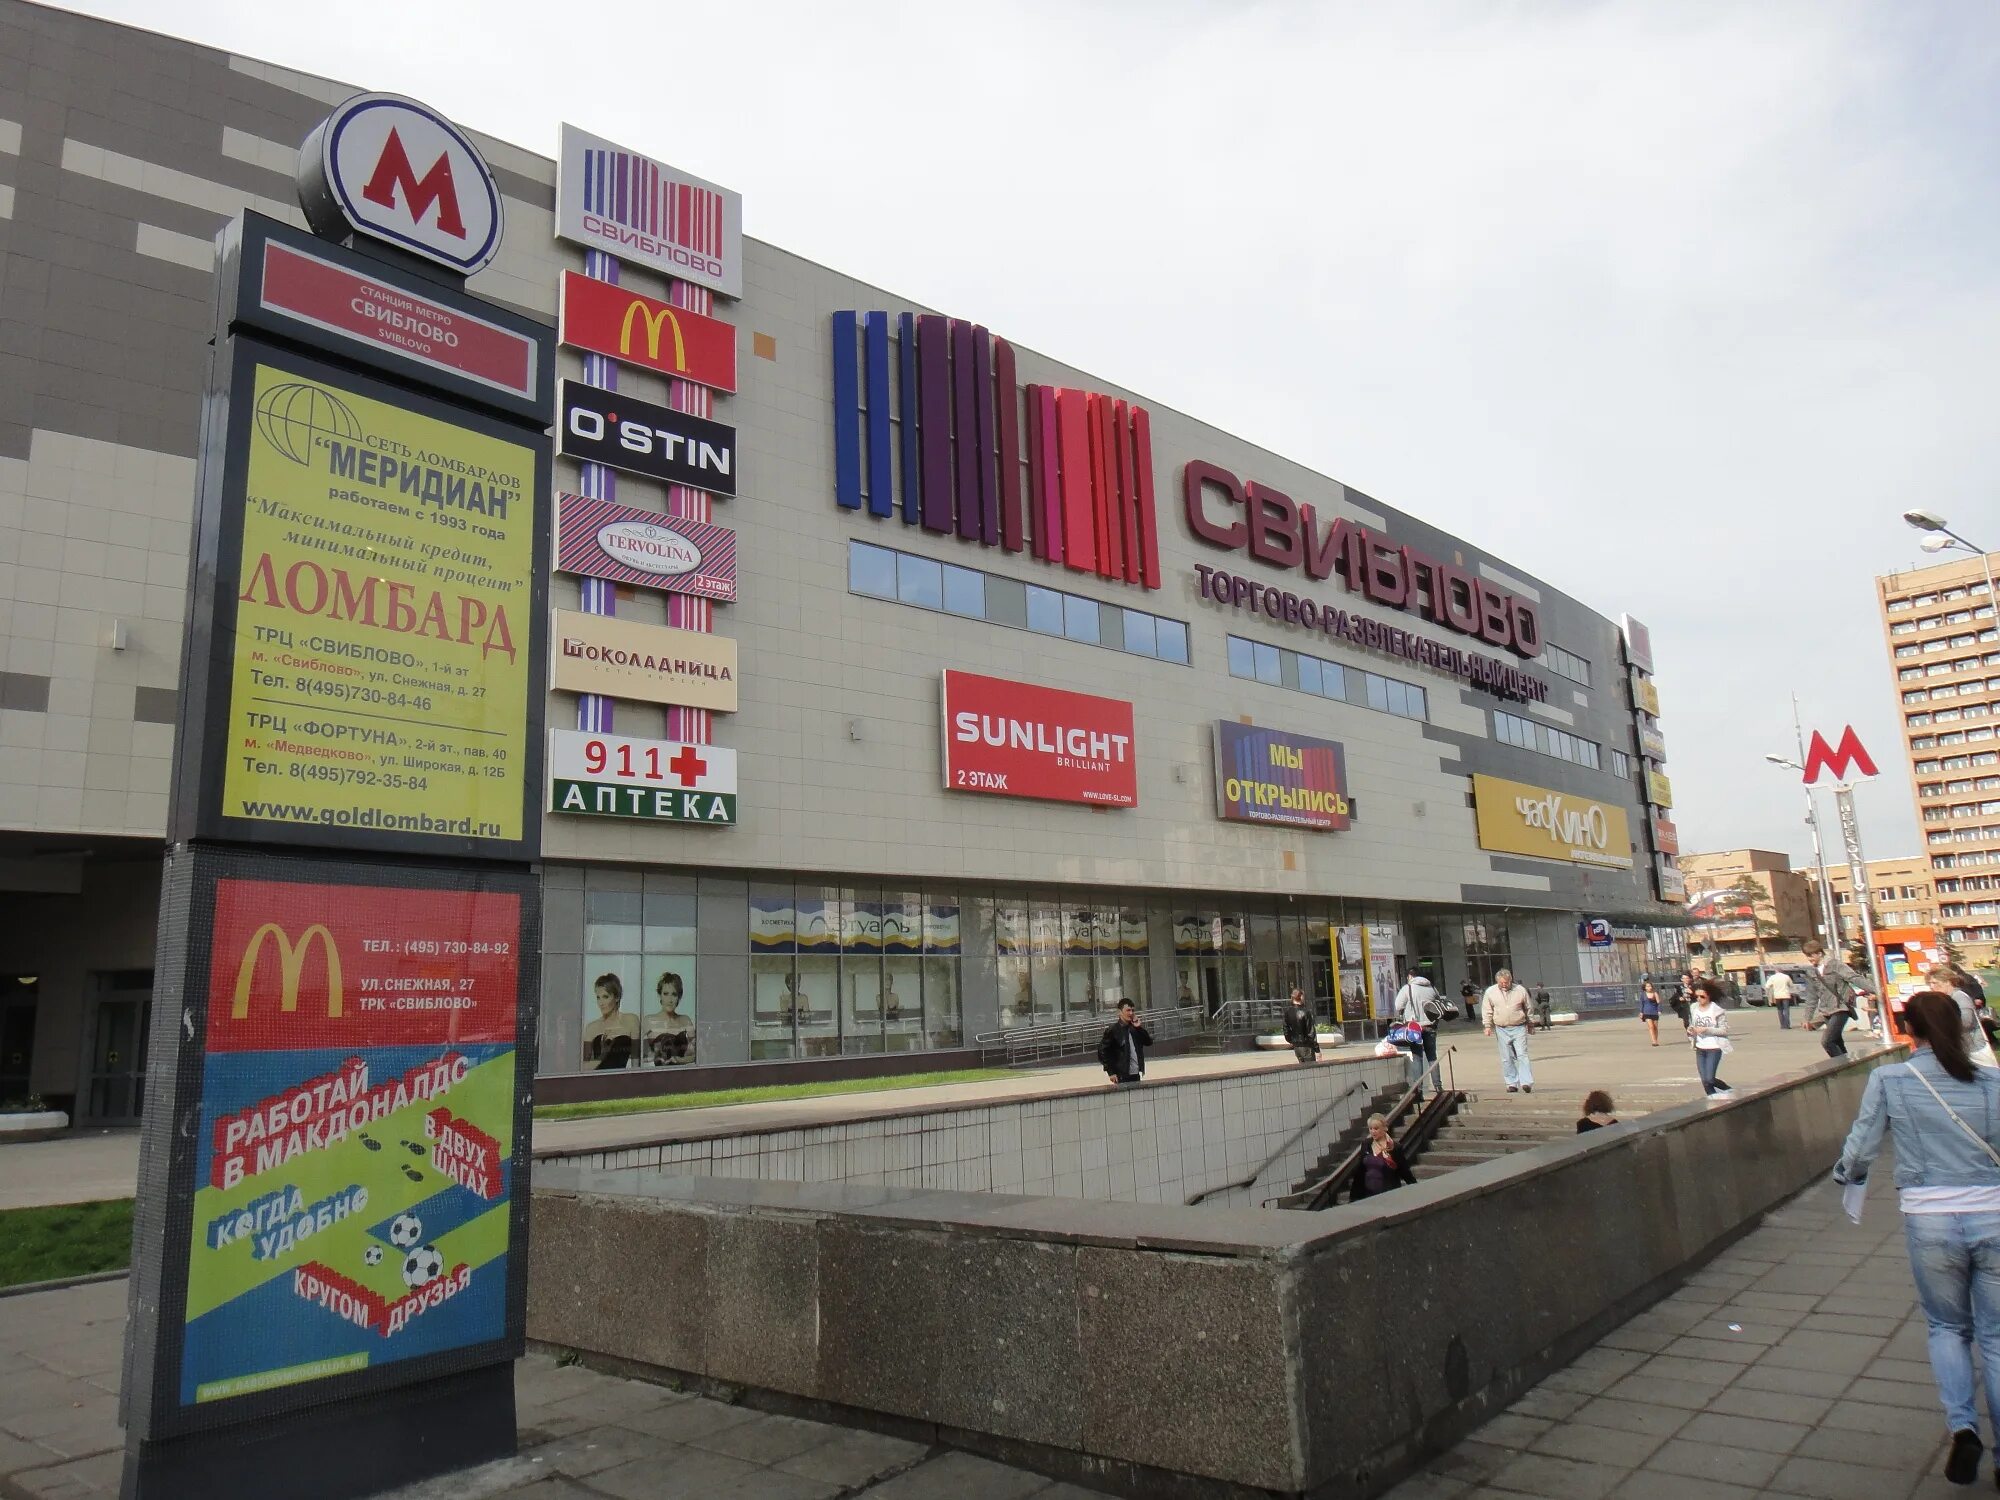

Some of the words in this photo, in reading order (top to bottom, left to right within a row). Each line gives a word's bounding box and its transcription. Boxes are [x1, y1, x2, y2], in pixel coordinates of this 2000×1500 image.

[363, 125, 467, 240] М
[584, 215, 722, 278] СВИБЛОВО
[350, 298, 458, 348] СВИБЛОВО
[360, 285, 412, 312] СТАНЦИЯ
[415, 303, 451, 326] МЕТРО
[378, 328, 432, 354] SVIBLOVO
[365, 434, 412, 457] СЕТЬ
[415, 450, 521, 489] ЛОМБАРДОВ
[328, 487, 410, 517] работаем
[415, 509, 425, 520] с
[430, 512, 467, 531] 1993
[472, 524, 506, 541] года
[282, 530, 427, 574] минимальный
[420, 543, 492, 570] кредит,
[606, 534, 693, 562] TERVOLINA
[1184, 458, 1542, 659] СВИБЛОВО
[697, 575, 704, 587] 2
[705, 581, 731, 593] этаж
[239, 552, 516, 665] ЛОМБАРД
[253, 625, 294, 649] ТРЦ
[432, 661, 452, 675] 1-й
[455, 666, 469, 677] эт
[1194, 563, 1508, 689] ТОРГОВО-РАЗВЛЕКАТЕЛЬНЫЙ
[1508, 668, 1549, 704] ЦЕНТР
[252, 651, 268, 663] м.
[369, 672, 388, 683] ул.
[392, 673, 454, 694] Снежная,
[457, 685, 469, 697] д.
[472, 686, 487, 698] 27
[563, 637, 733, 682] ШОКОЛАДНИЦА
[250, 668, 290, 690] Тел.
[295, 676, 432, 711] 8(495)730-84-46
[244, 738, 261, 750] м.
[379, 755, 399, 768] ул.
[403, 755, 465, 776] Широкая,
[468, 765, 480, 777] д.
[246, 712, 287, 734] ТРЦ
[415, 738, 436, 753] 2-й
[464, 746, 490, 759] пав.
[492, 748, 507, 760] 40
[956, 711, 1129, 763] SUNLIGHT
[1269, 743, 1304, 770] МЫ
[243, 757, 283, 776] Тел.
[289, 762, 428, 792] 8(495)792-35-84
[585, 740, 664, 780] 911
[957, 769, 966, 785] 2
[969, 770, 1008, 790] ЭТАЖ
[1057, 757, 1111, 772] BRILLIANT
[242, 800, 501, 837] www.goldlombard.ru
[562, 783, 729, 821] АПТЕКА
[1226, 778, 1348, 815] ОТКРЫЛИСЬ
[404, 940, 440, 956] (495)
[443, 941, 510, 955] 730-84-92
[359, 998, 386, 1011] ТРК
[389, 997, 478, 1010] «СВИБЛОВО»
[459, 978, 475, 991] 27
[223, 1157, 246, 1190] В
[256, 1055, 470, 1175] МАКДОНАЛДС
[225, 1061, 369, 1154] РАБОТАЙ
[424, 1114, 435, 1139] В
[439, 1124, 487, 1170] ДВУХ
[431, 1145, 489, 1200] ШАГАХ
[216, 1188, 304, 1250] КОГДА
[260, 1186, 369, 1261] УДОБНО
[293, 1268, 369, 1329] КРУГОМ
[387, 1266, 471, 1338] ДРУЗЬЯ
